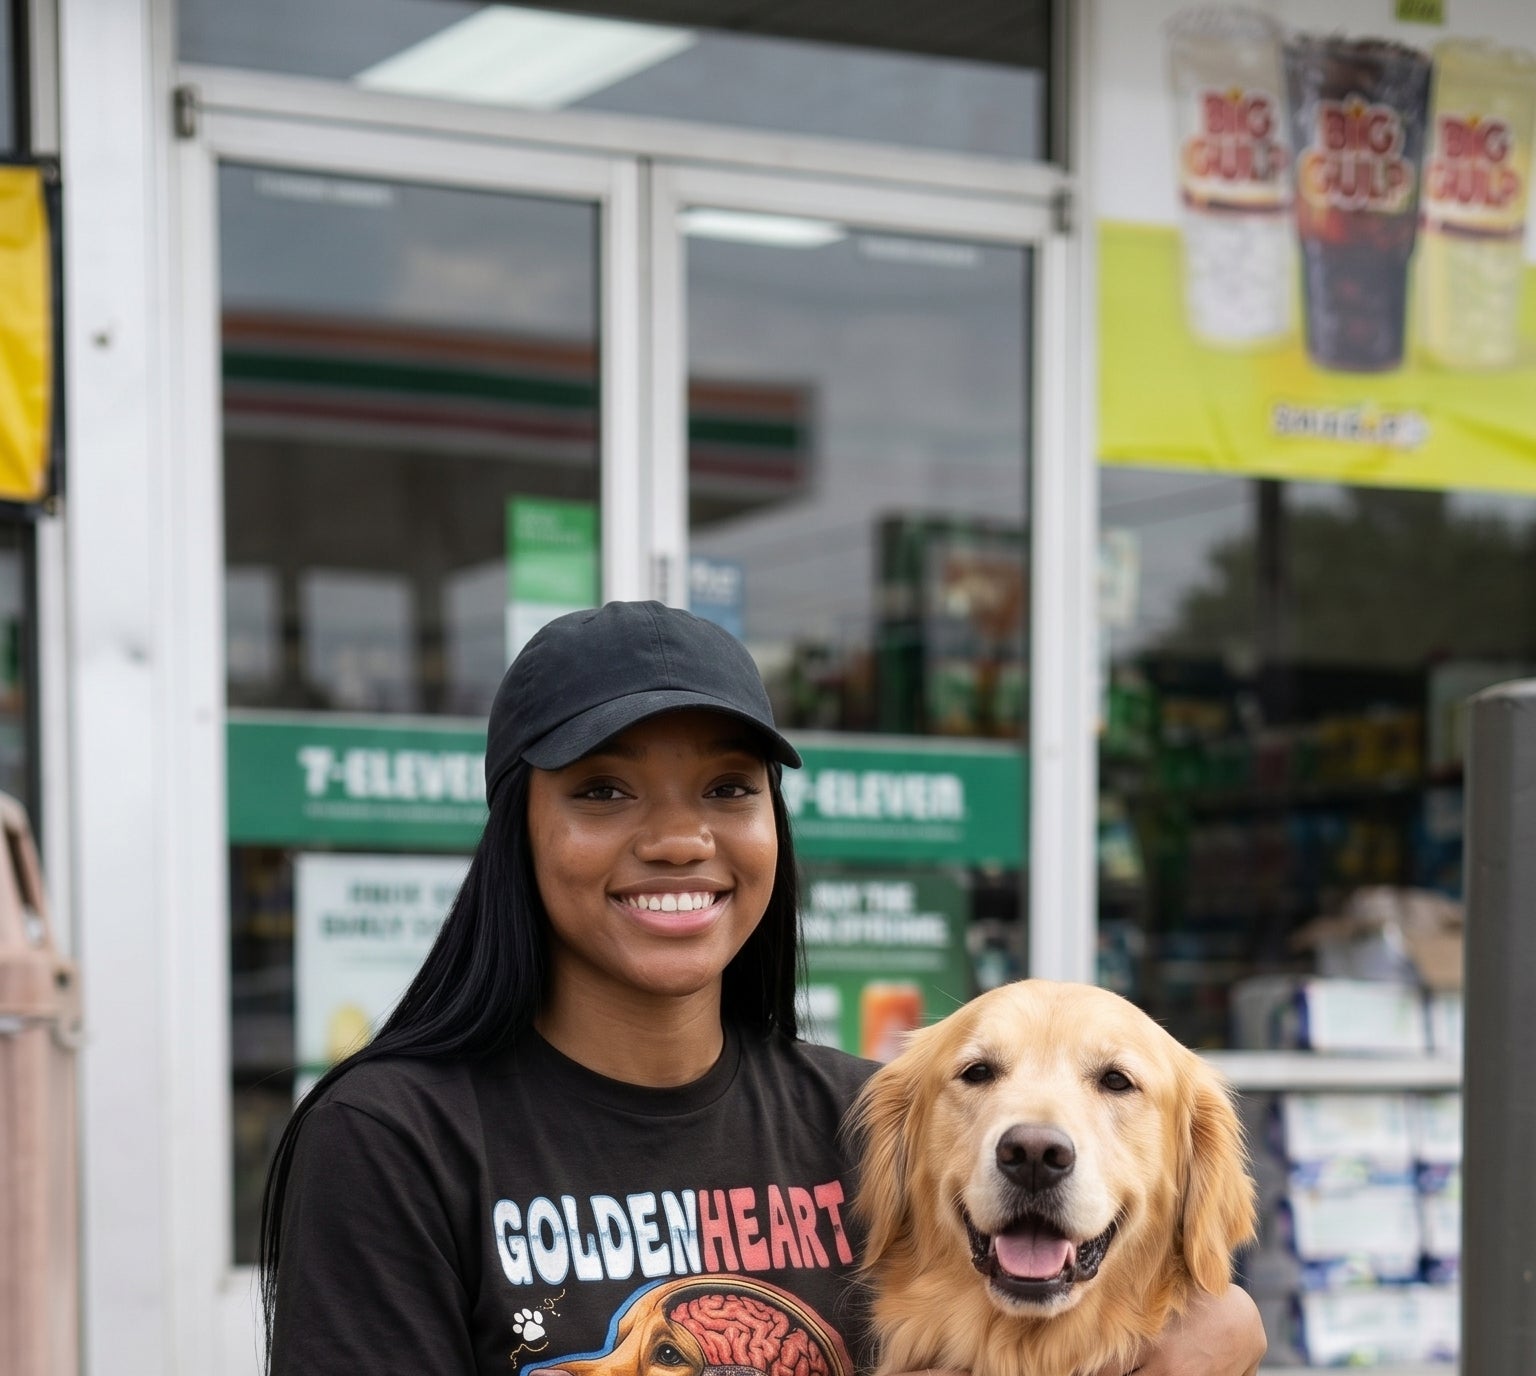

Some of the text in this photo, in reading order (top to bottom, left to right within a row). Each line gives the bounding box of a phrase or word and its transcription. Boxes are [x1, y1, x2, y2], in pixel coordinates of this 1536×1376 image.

[1203, 90, 1273, 139] BIG
[1322, 104, 1396, 155] BIG
[1183, 139, 1289, 181] GULP
[1441, 118, 1511, 163] BIG
[1302, 154, 1411, 200] GULP
[1426, 161, 1521, 208] GULP
